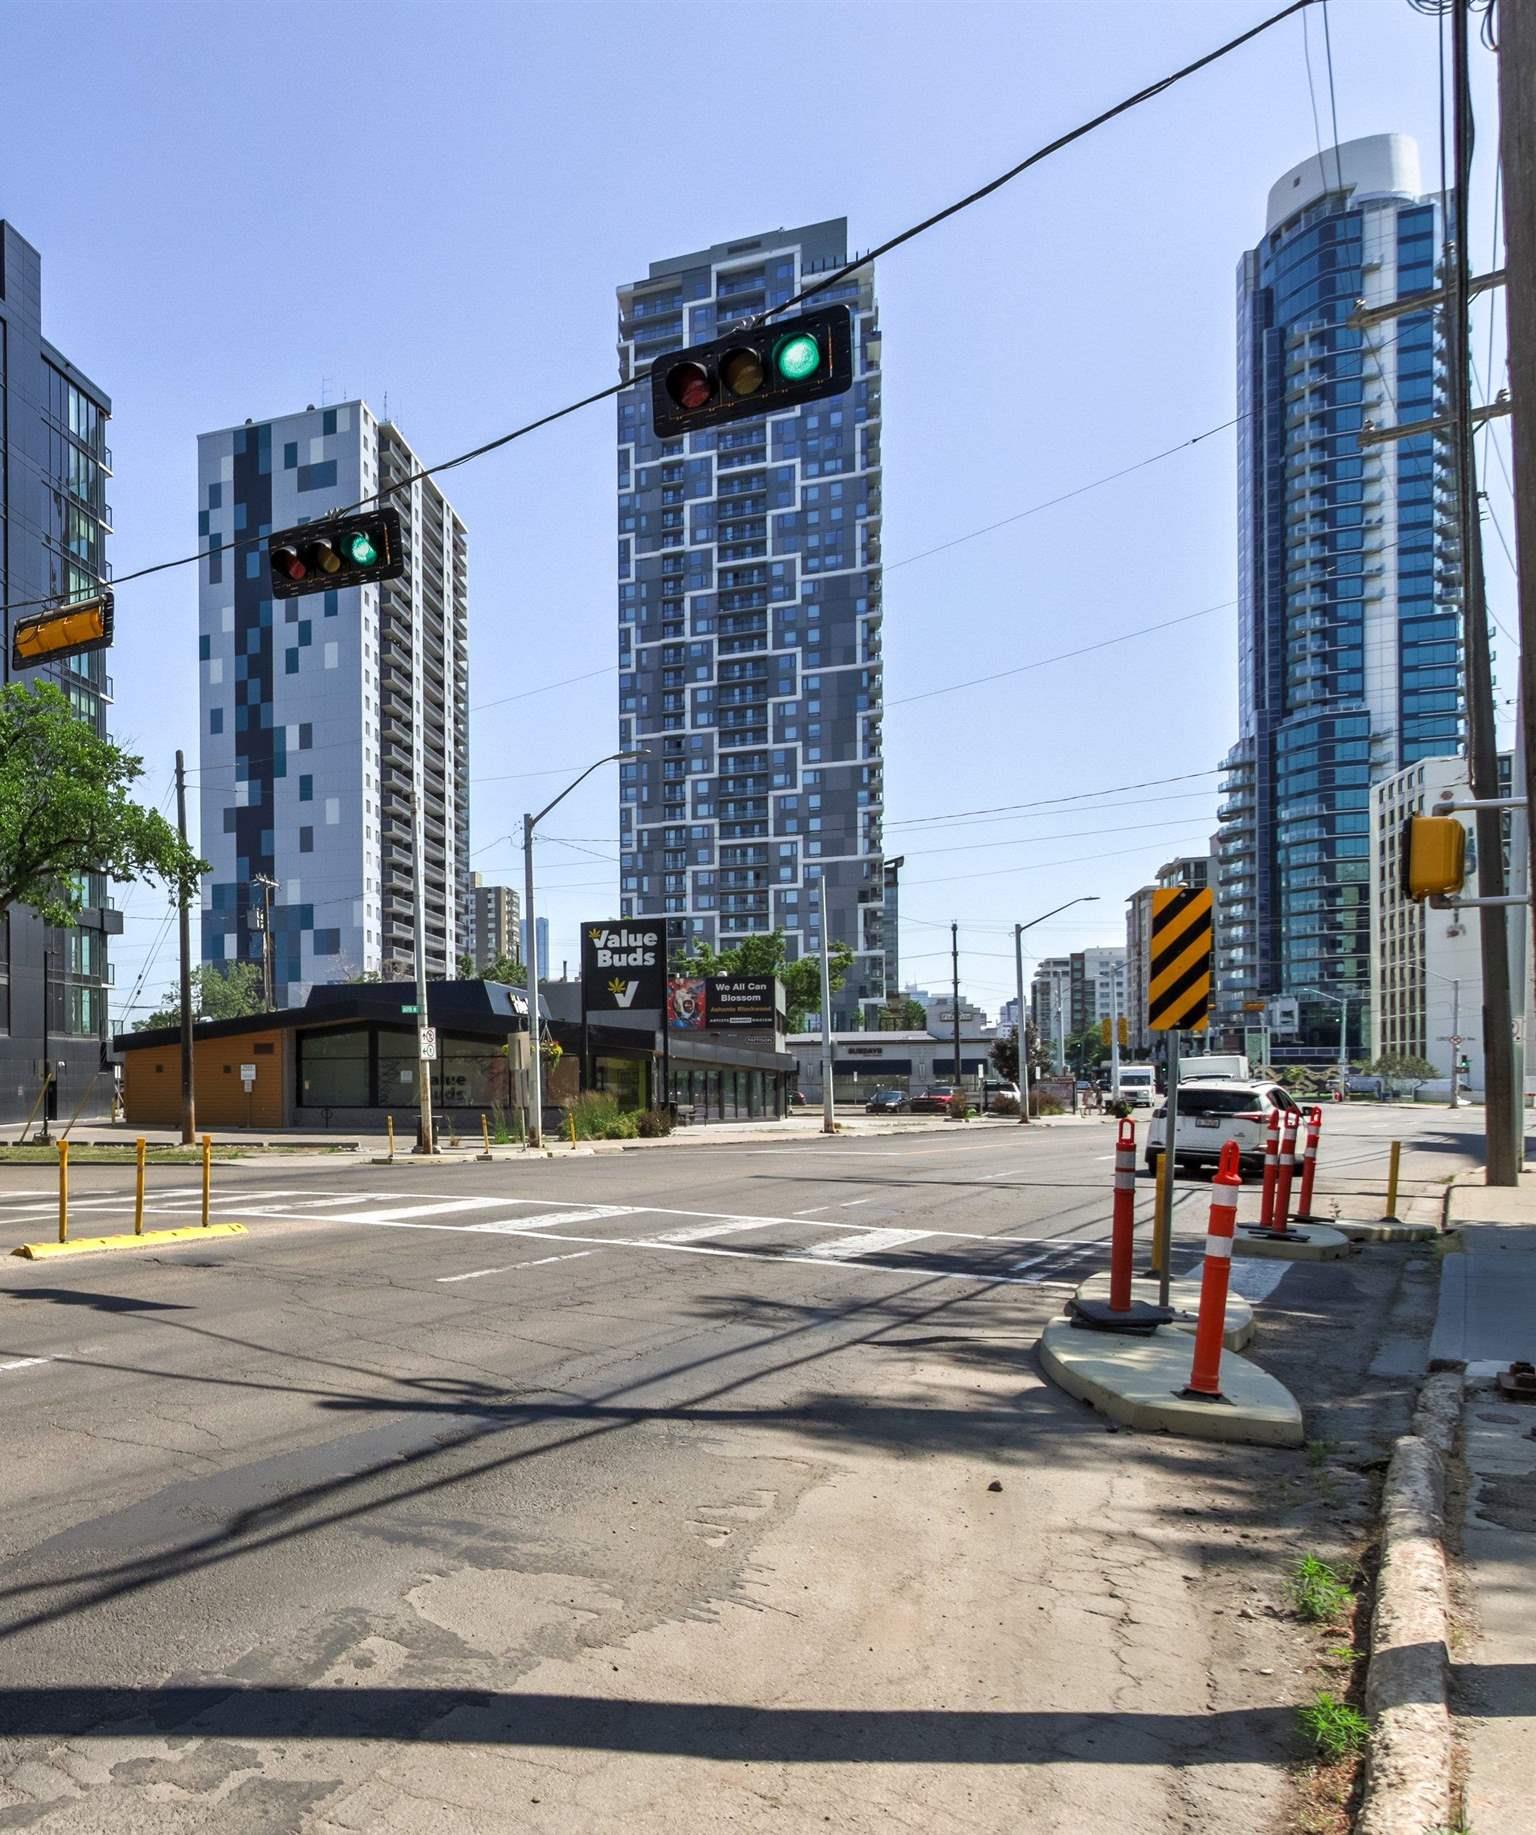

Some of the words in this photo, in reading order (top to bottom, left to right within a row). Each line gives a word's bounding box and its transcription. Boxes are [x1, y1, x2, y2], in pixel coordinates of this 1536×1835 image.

[590, 929, 658, 948] Value
[597, 947, 656, 968] Buds
[715, 983, 730, 991] We
[732, 982, 745, 991] All
[748, 982, 767, 991] Can
[720, 994, 761, 1002] Blossom
